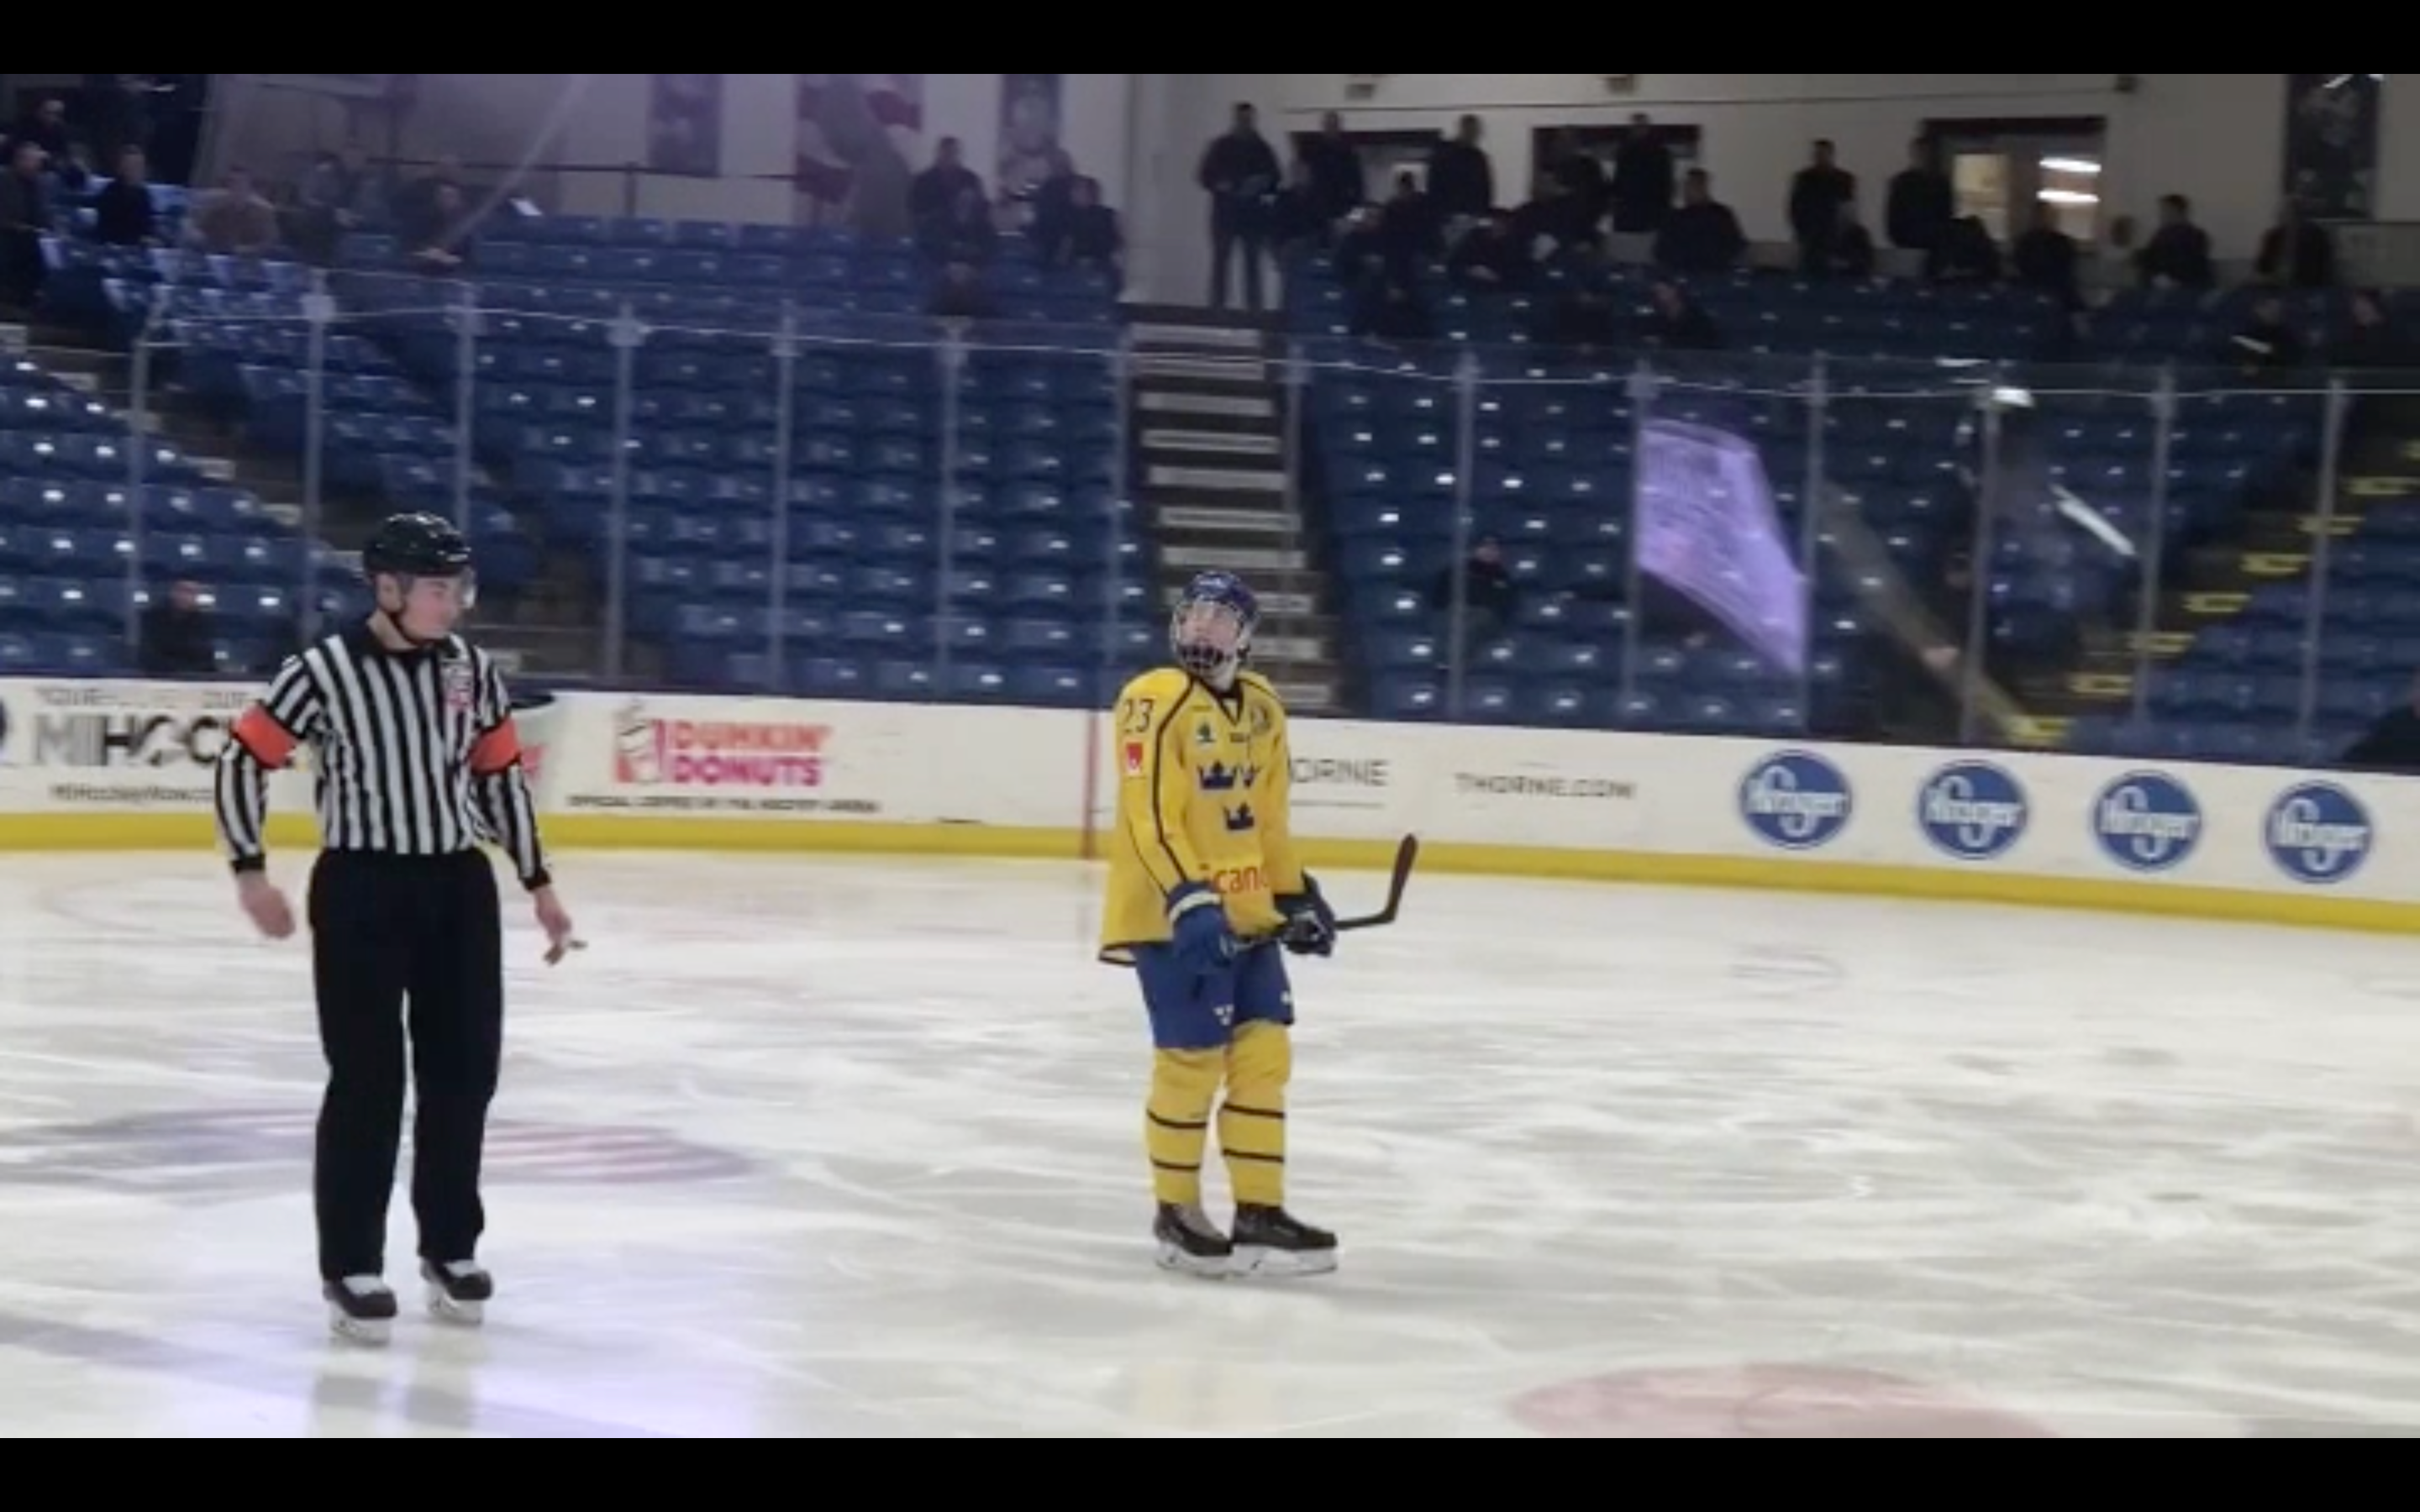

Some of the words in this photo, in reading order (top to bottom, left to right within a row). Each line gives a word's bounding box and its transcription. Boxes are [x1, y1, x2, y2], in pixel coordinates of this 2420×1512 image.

[1121, 697, 1155, 733] 23
[674, 754, 820, 786] DONUTS
[1289, 757, 1391, 787] ORNE
